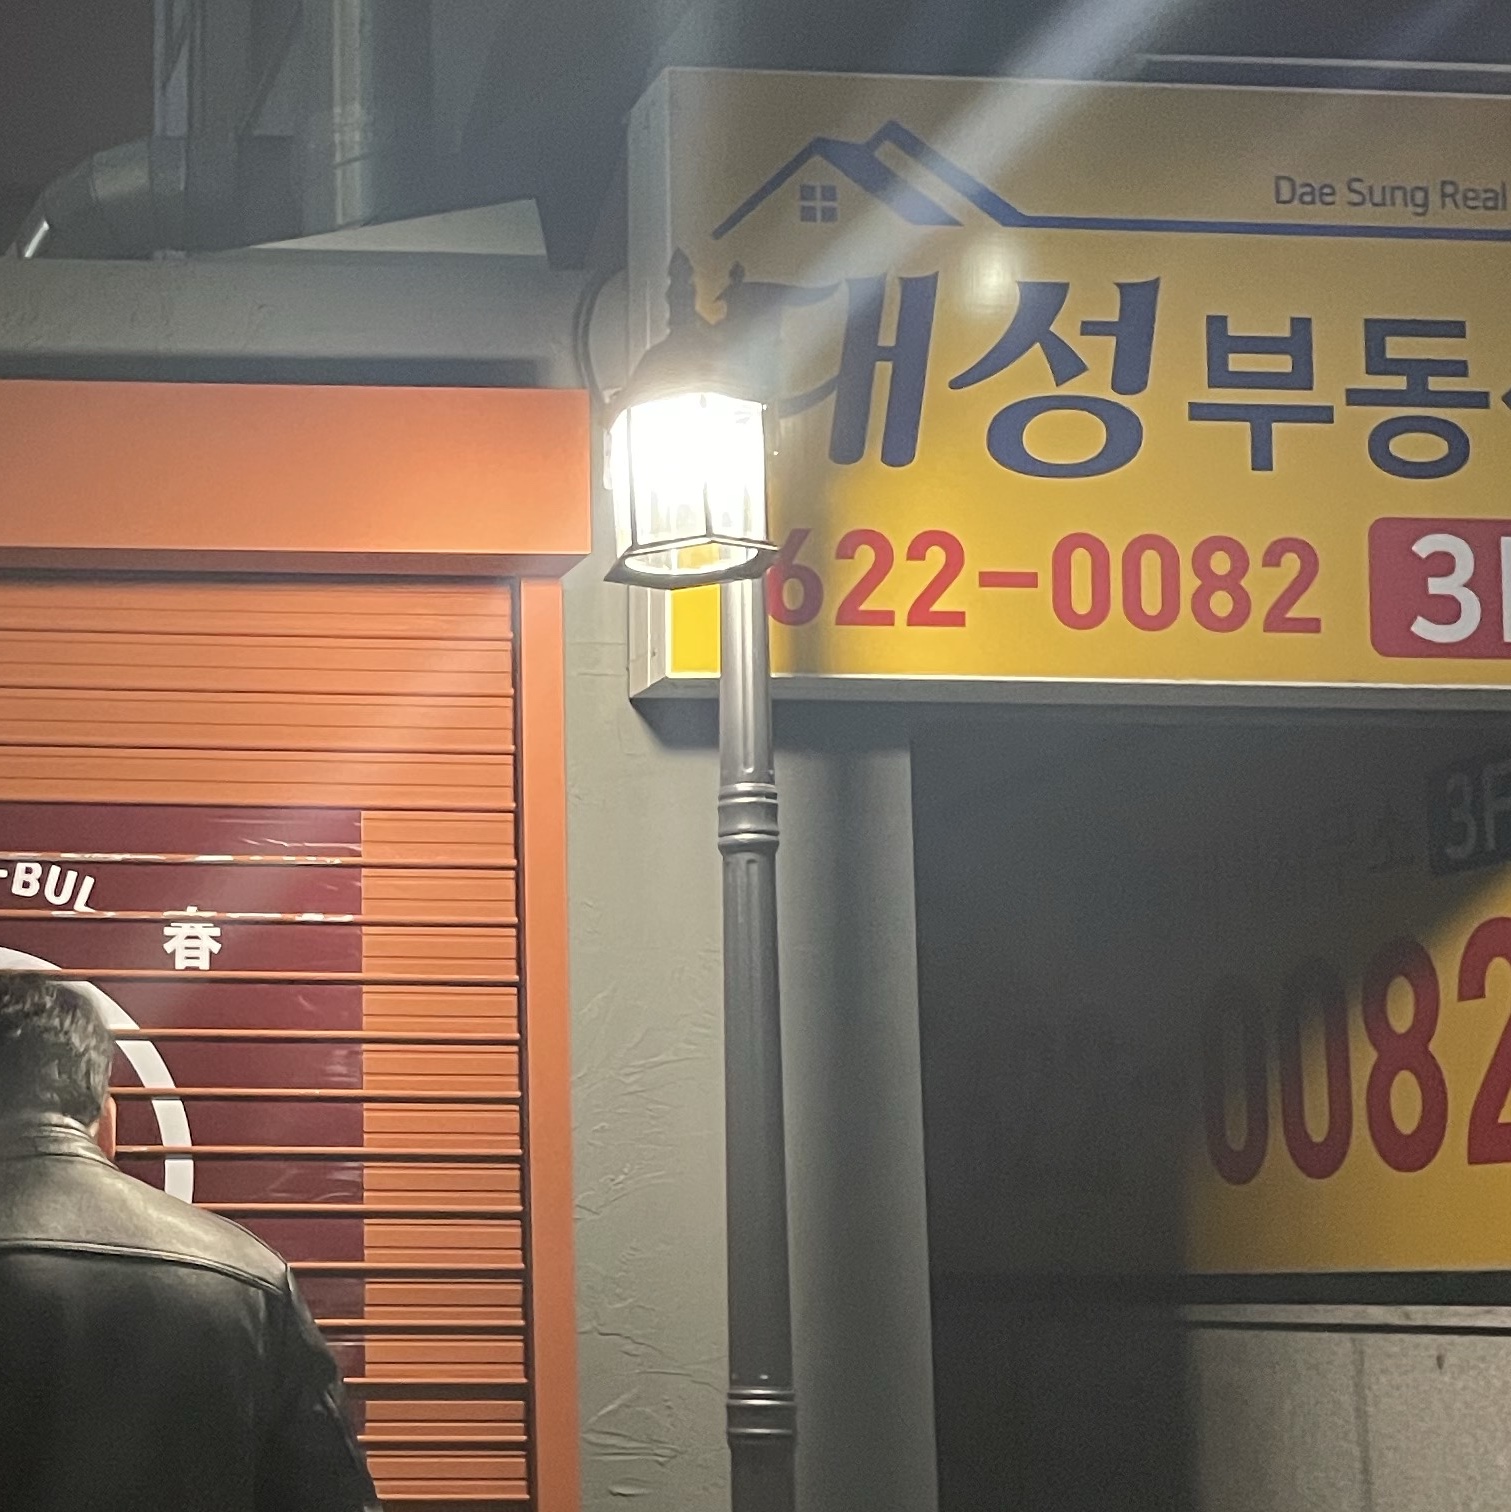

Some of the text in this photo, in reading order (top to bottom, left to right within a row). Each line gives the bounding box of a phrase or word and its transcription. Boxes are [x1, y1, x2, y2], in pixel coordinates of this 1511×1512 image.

[1274, 175, 1507, 217] Dae Sung Real
[768, 527, 1322, 635] 622-0082
[1410, 533, 1511, 643] 3
